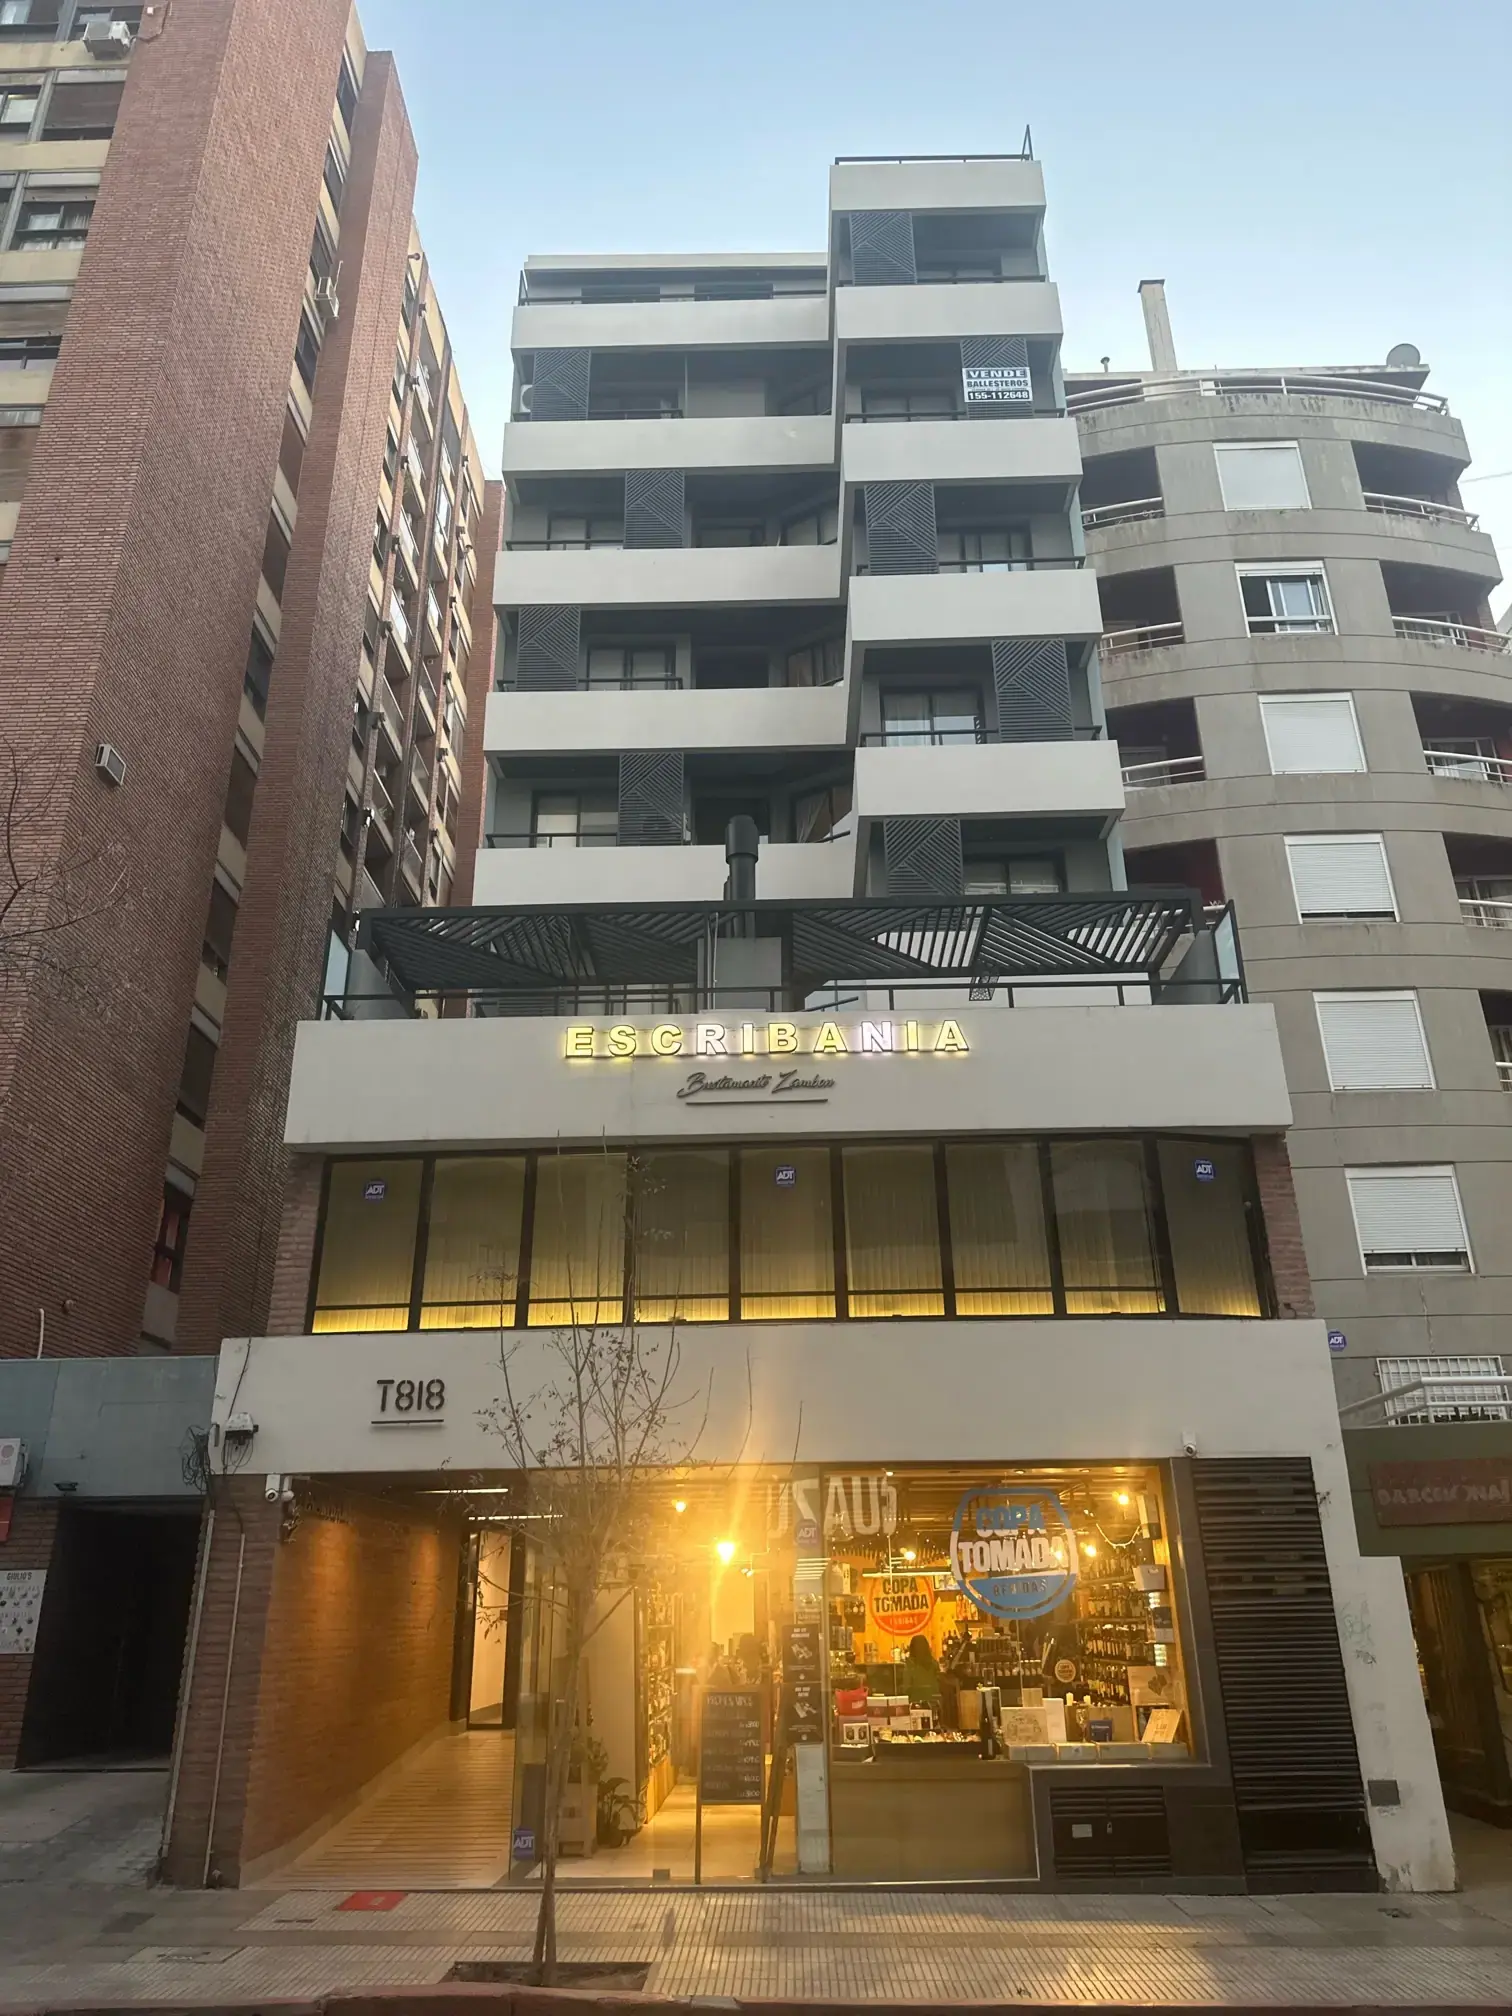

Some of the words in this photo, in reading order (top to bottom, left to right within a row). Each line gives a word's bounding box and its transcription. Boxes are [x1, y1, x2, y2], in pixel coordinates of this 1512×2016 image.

[968, 369, 1026, 378] VENDE
[967, 379, 1028, 388] BALLESTEROS
[968, 391, 1029, 400] 155-112648
[564, 1019, 970, 1058] ESCRIBANIA
[777, 1170, 794, 1180] ADT
[1196, 1164, 1213, 1174] ADT
[365, 1184, 385, 1194] ADT
[1329, 1336, 1344, 1345] ADT
[376, 1378, 445, 1412] T818
[976, 1503, 1047, 1538] COPA
[798, 1527, 817, 1539] ADT
[958, 1535, 1069, 1573] TOMADA
[882, 1576, 918, 1595] COPA
[874, 1594, 929, 1613] TOMADA
[513, 1835, 535, 1849] ADT
